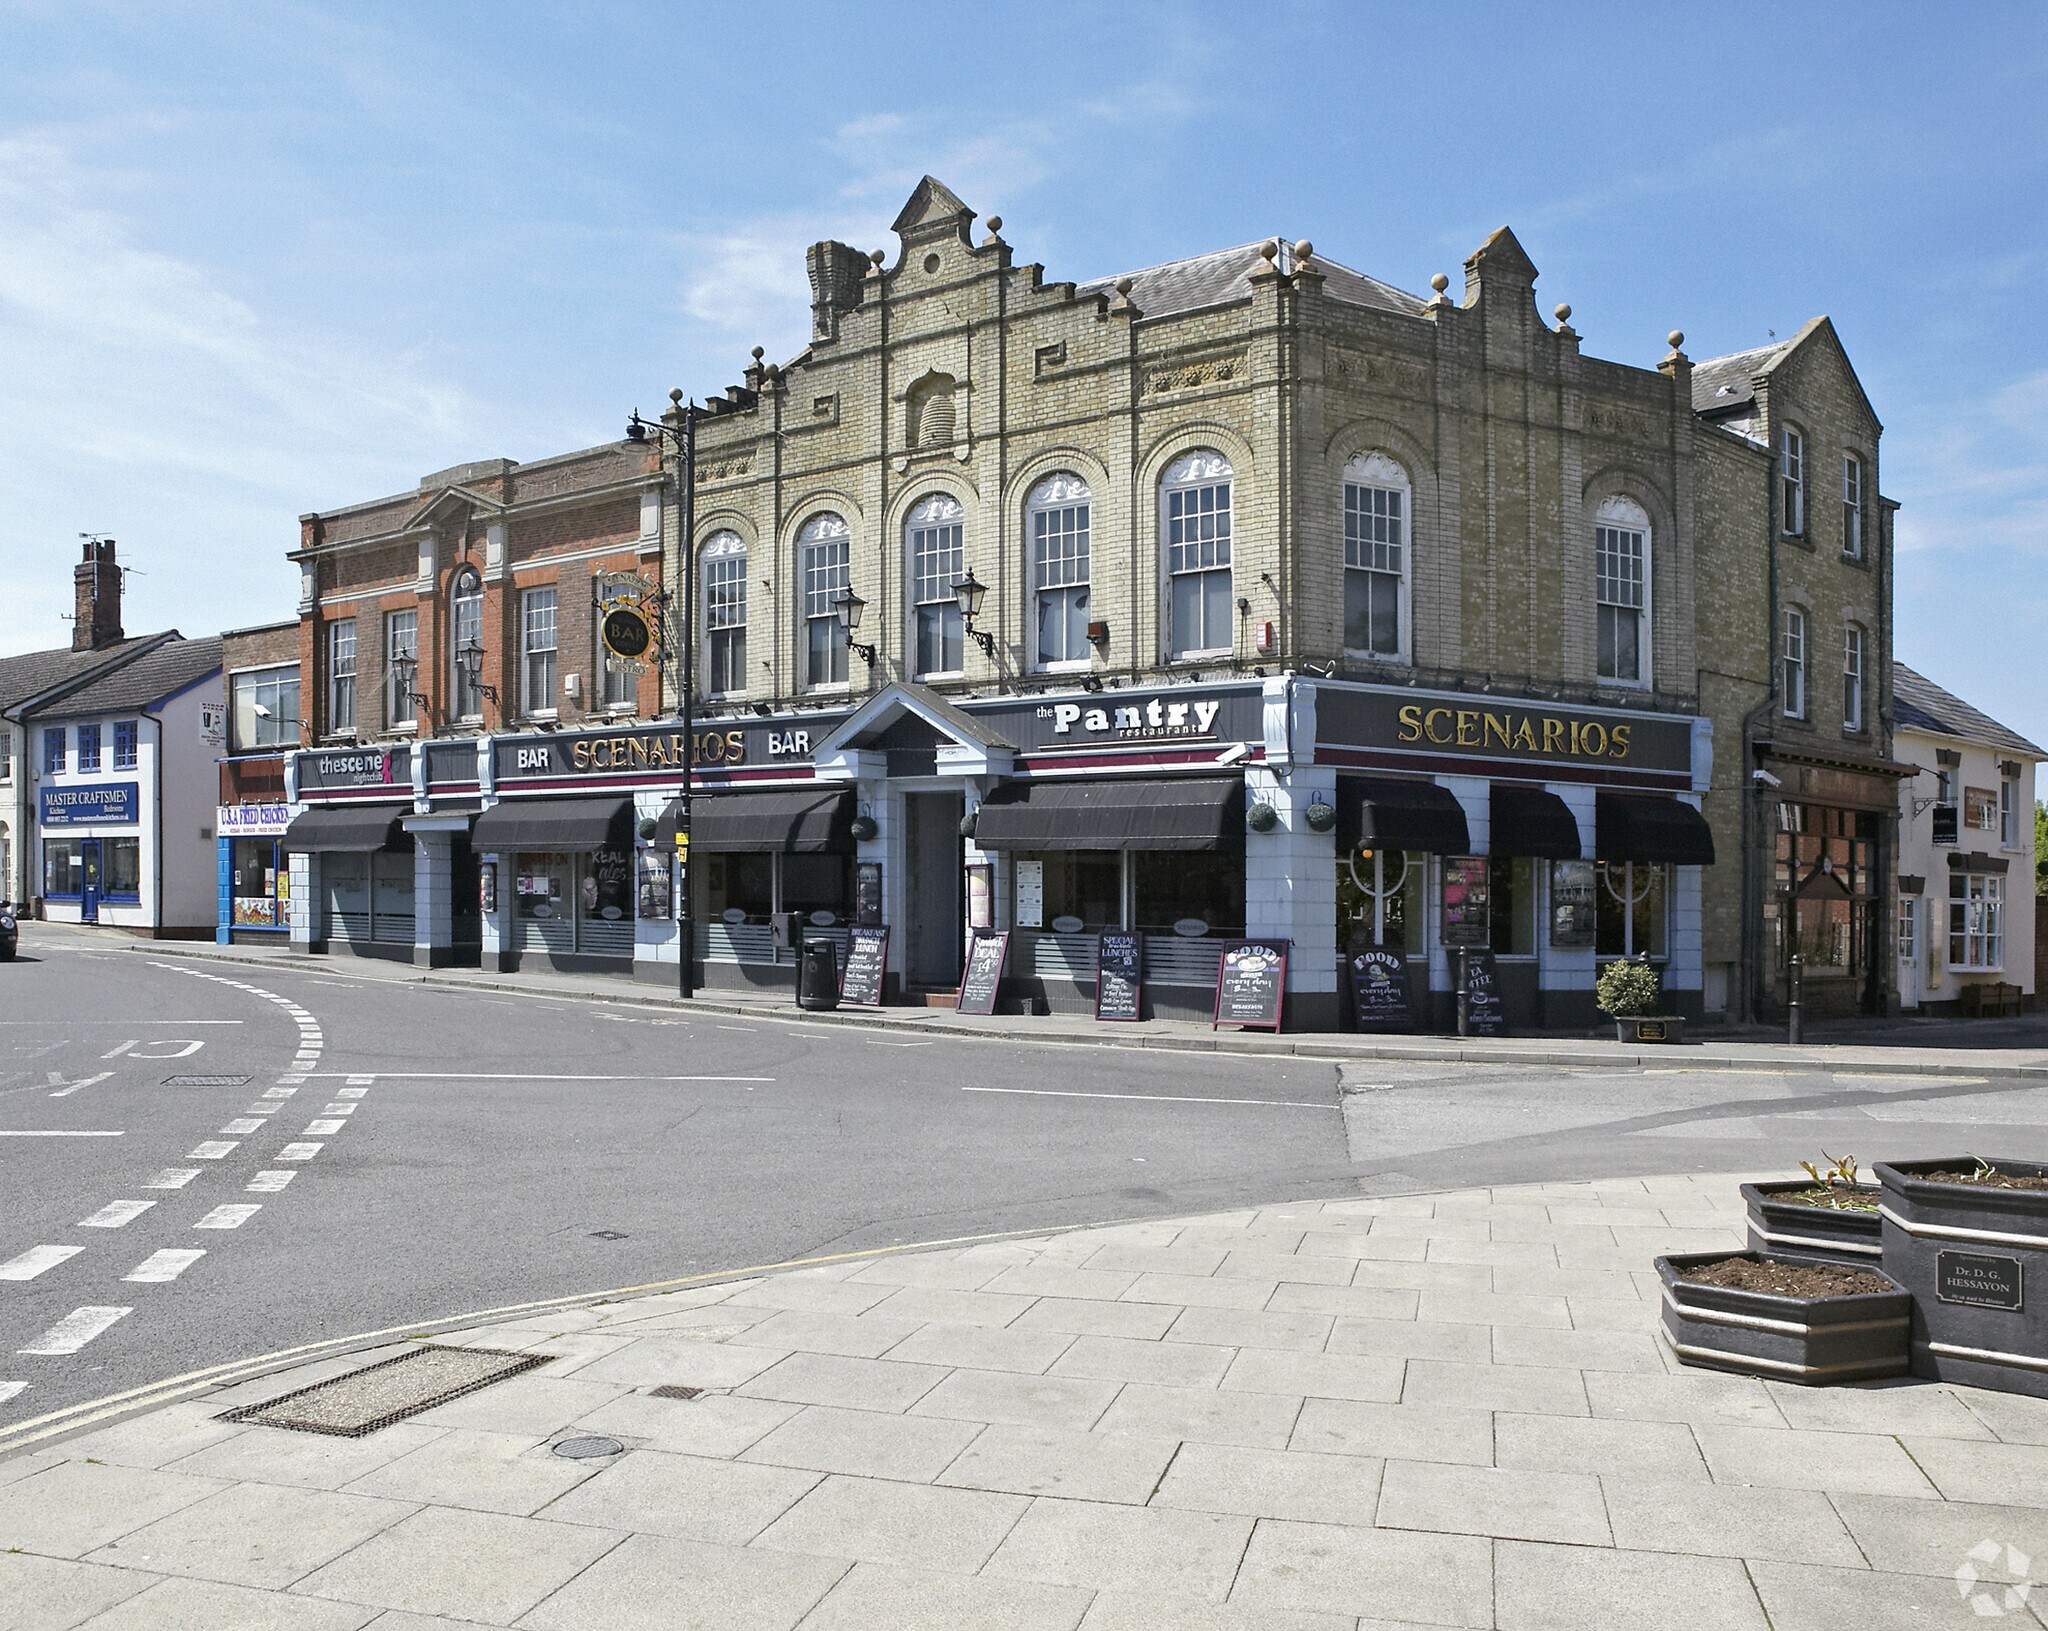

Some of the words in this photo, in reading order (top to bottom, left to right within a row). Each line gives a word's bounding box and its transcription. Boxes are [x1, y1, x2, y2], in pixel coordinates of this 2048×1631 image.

[611, 624, 644, 641] BAR
[1036, 705, 1054, 719] the
[1053, 698, 1220, 734] Pantry
[1119, 724, 1198, 738] restaurant
[1397, 704, 1632, 759] SCENARIOS
[768, 731, 809, 754] BAR
[518, 748, 549, 769] BAR
[353, 771, 383, 785] nightclub
[45, 792, 78, 807] MASTER
[78, 789, 128, 804] CRAFTSMEN
[239, 808, 259, 825] FRIED
[851, 928, 886, 937] BREAKFAST
[1103, 936, 1137, 945] SPECIAL
[974, 946, 1001, 959] DEAL
[1102, 948, 1138, 957] LUNCHES
[1955, 1266, 1972, 1276] Dr.
[1974, 1268, 1987, 1278] D.
[1988, 1270, 2001, 1280] G.
[1946, 1277, 2010, 1293] HESSAYON
